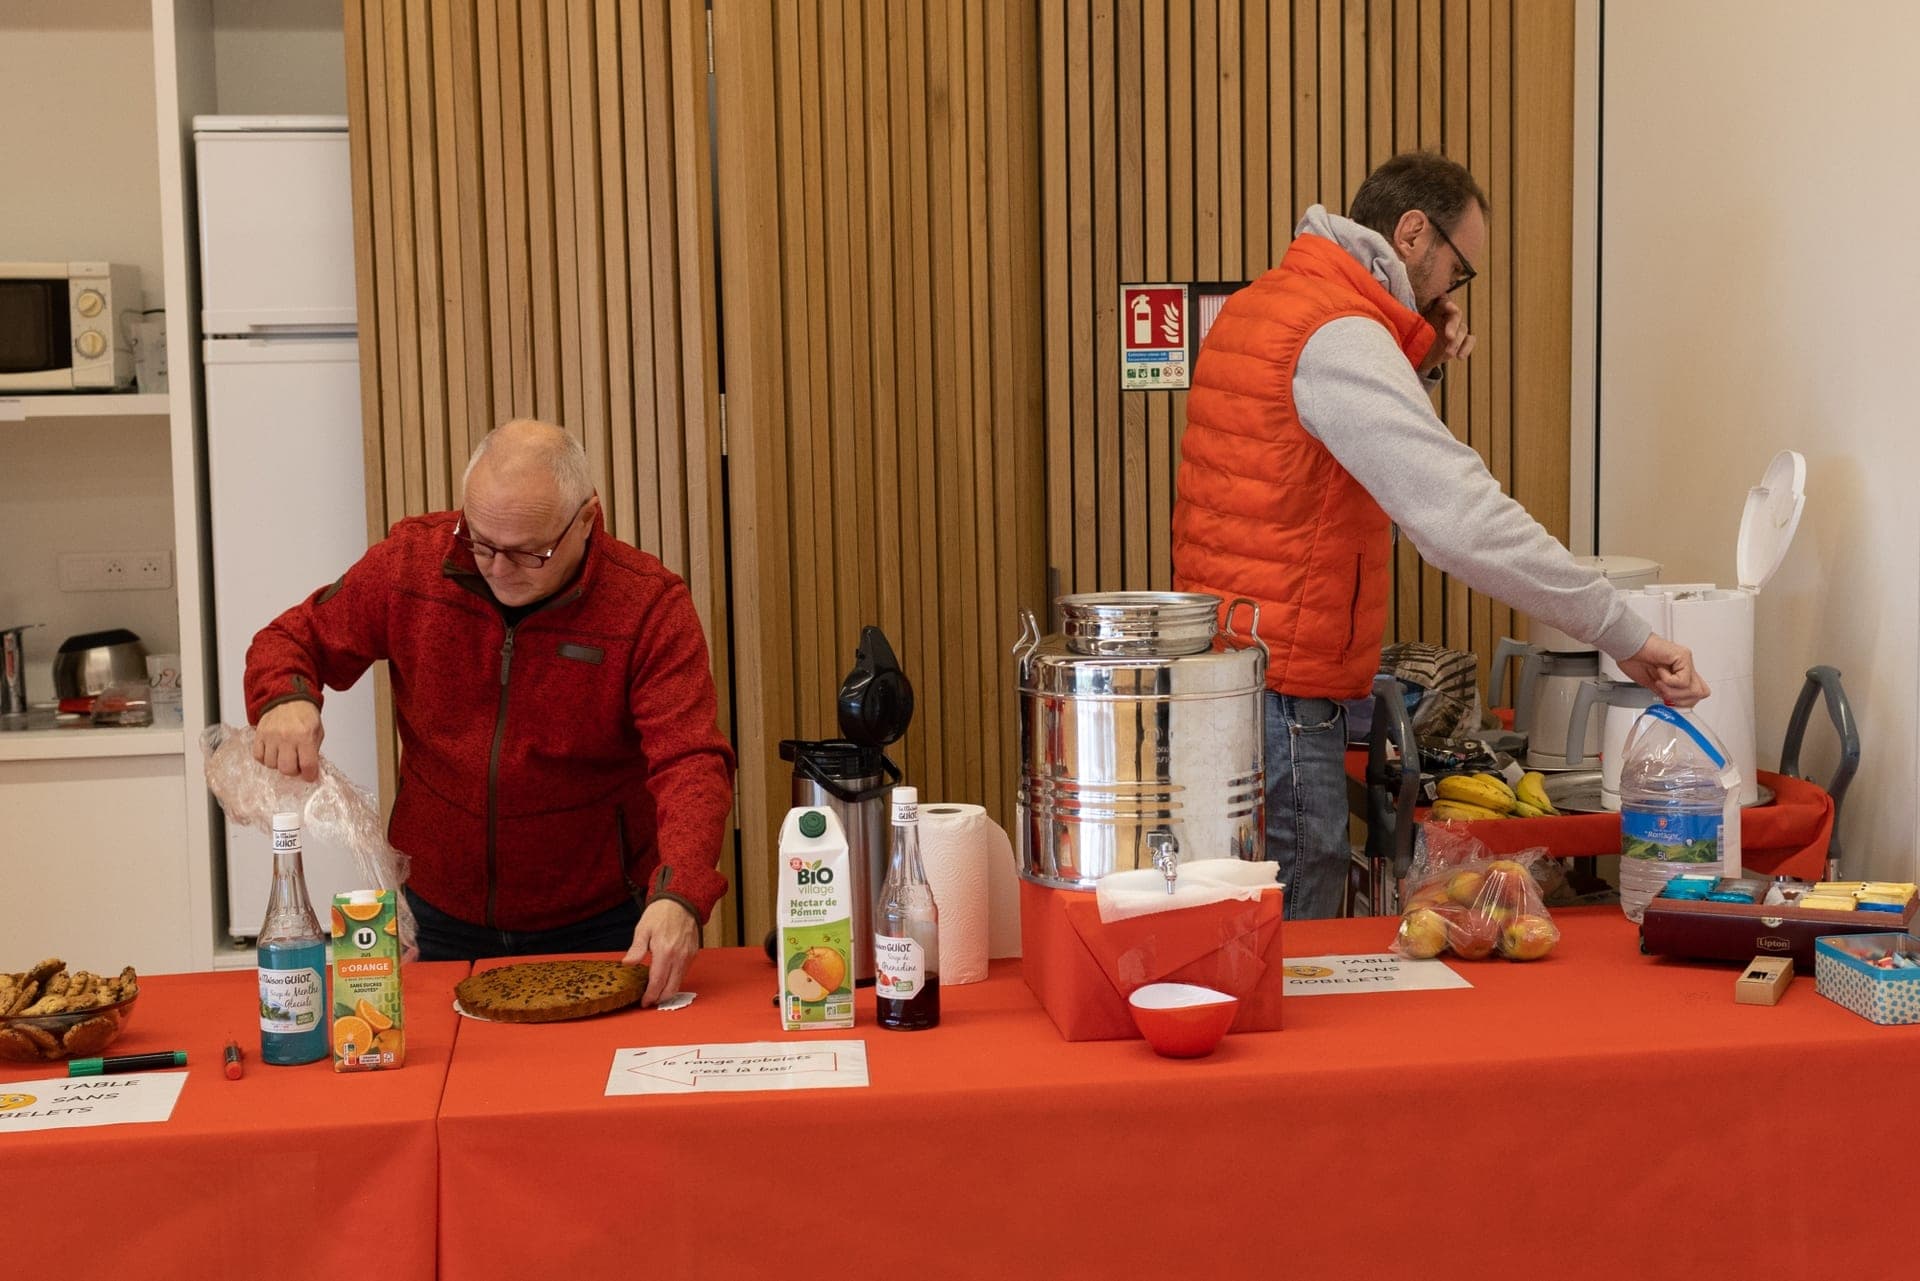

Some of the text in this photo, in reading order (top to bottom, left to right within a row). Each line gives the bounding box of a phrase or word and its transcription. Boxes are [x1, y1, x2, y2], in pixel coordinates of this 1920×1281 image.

[1658, 851, 1668, 861] 5L
[799, 884, 834, 896] village
[790, 898, 838, 908] Nectar de
[790, 908, 827, 917] Pomme
[358, 932, 372, 945] U
[1759, 938, 1788, 948] Lipton
[886, 943, 912, 953] GUIOT
[1336, 957, 1400, 965] TABLE
[1347, 966, 1400, 974] SANS
[1289, 975, 1395, 985] GOBELETS
[740, 1054, 812, 1065] gobelets
[690, 1066, 729, 1074] c'est
[759, 1064, 793, 1072] bas!
[59, 1079, 141, 1091] TABLE
[51, 1092, 120, 1104] SANS
